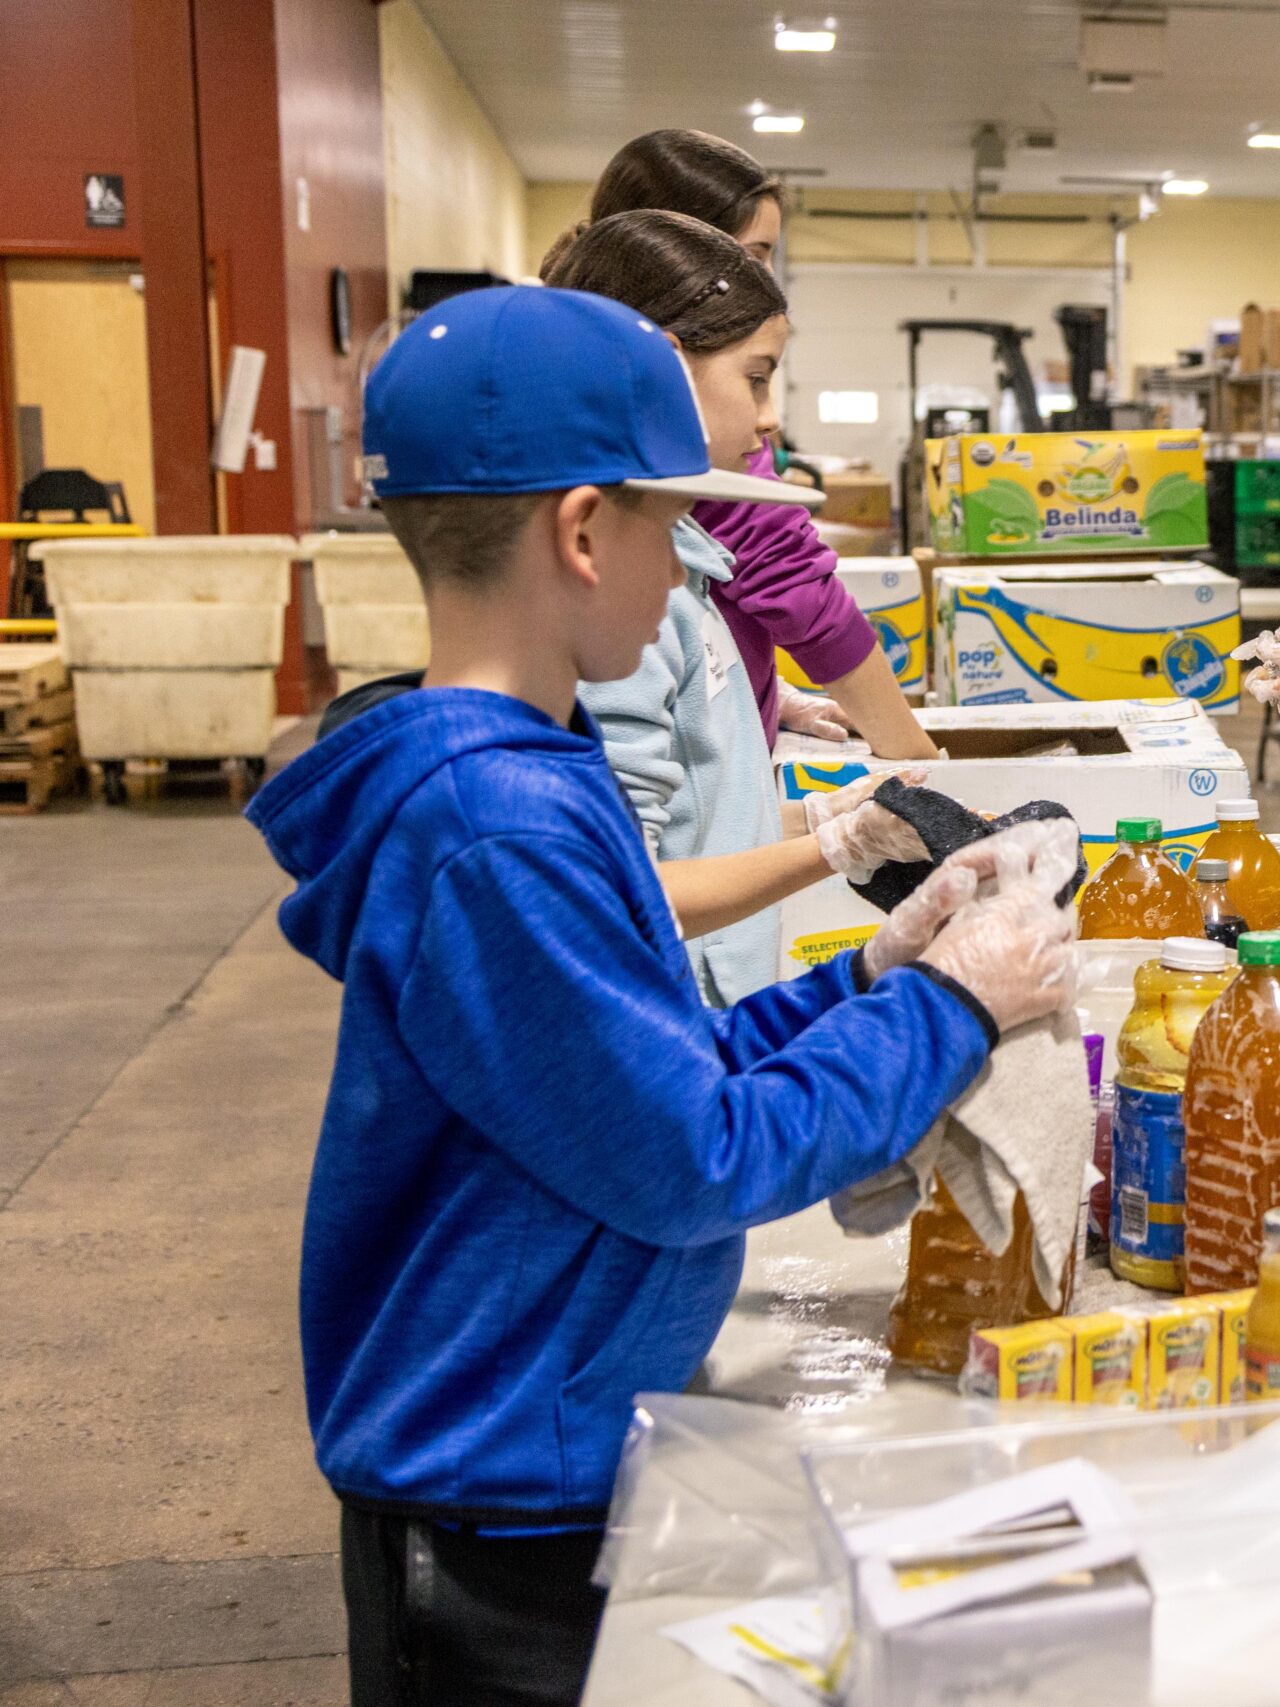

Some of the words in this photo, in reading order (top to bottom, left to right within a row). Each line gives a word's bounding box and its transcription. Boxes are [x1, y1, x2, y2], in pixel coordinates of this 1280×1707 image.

[1046, 506, 1137, 527] Belinda
[959, 651, 995, 668] pop
[801, 939, 851, 953] SELECTED
